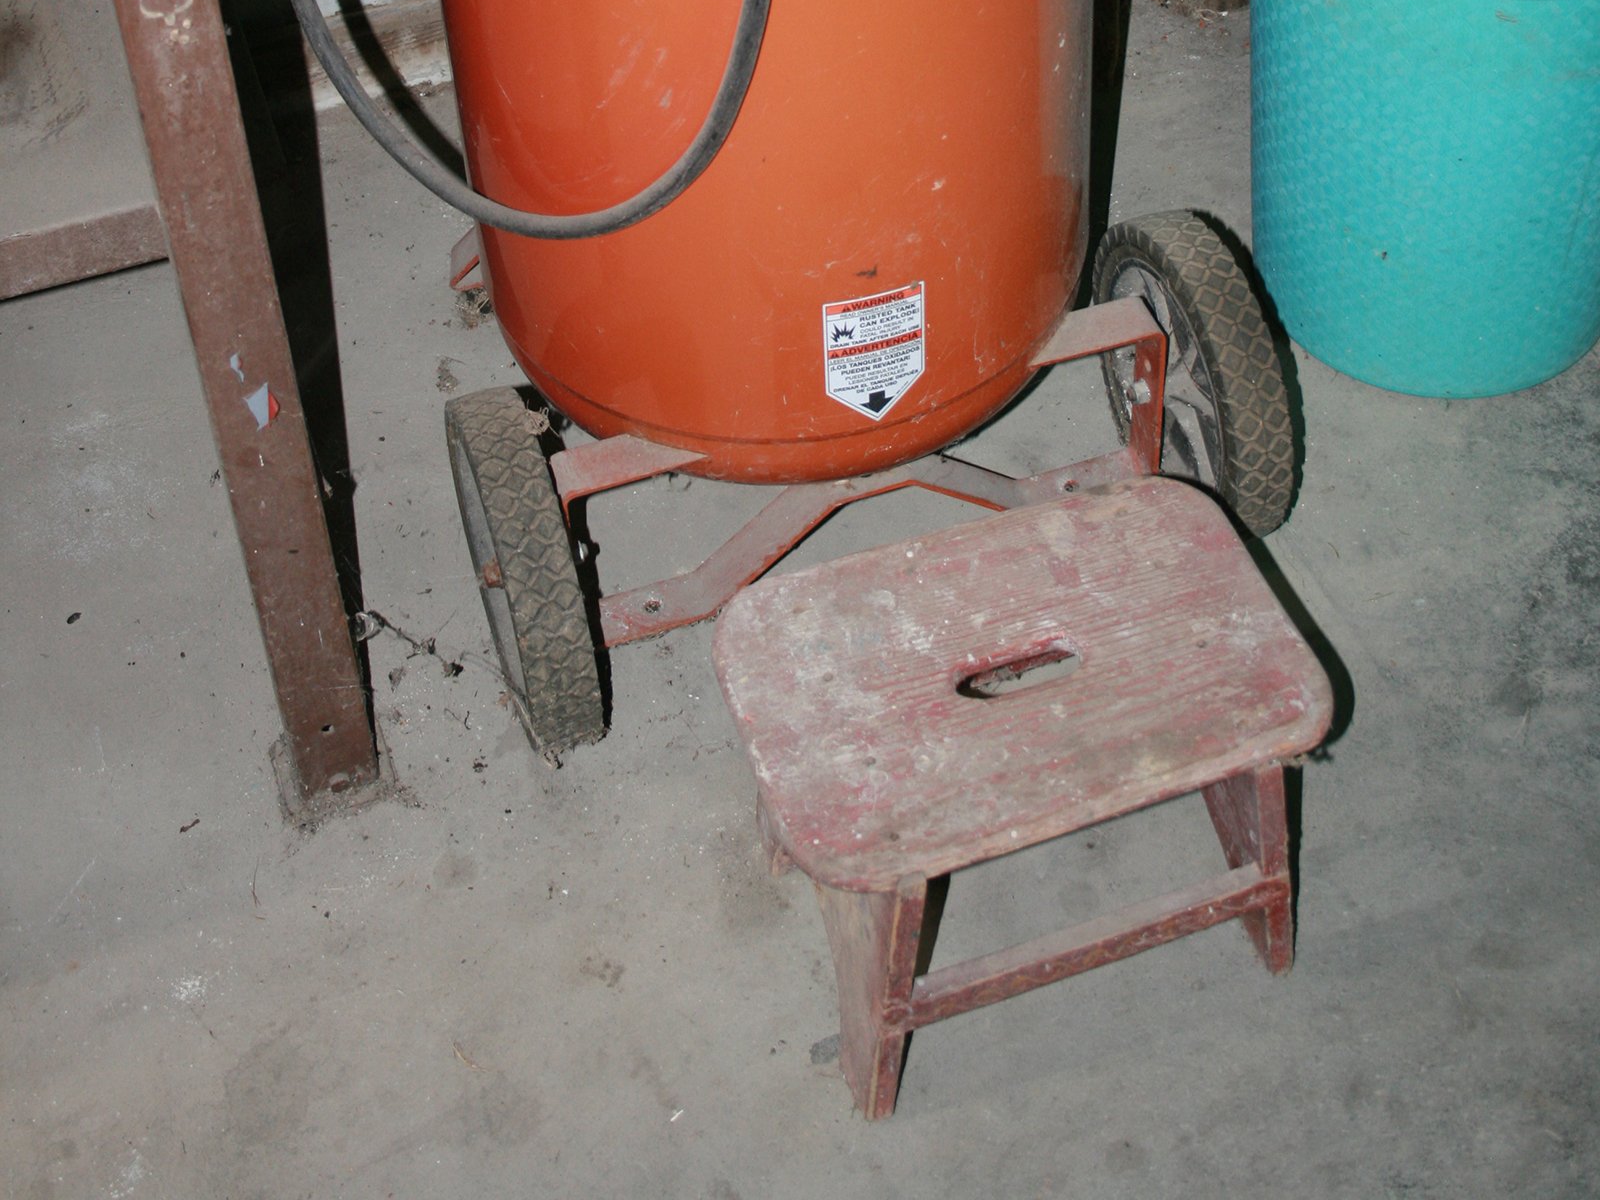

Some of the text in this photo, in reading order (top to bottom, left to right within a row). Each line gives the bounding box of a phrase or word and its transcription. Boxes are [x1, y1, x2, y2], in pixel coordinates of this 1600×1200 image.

[851, 291, 905, 311] WARNING
[859, 303, 916, 322] RUSTED TANK
[859, 321, 877, 329] CAN
[840, 332, 919, 357] ADVERTENCIA
[849, 357, 883, 369] TANQUES
[884, 345, 920, 360] OXIDADOS
[841, 366, 871, 376] PUEDEN
